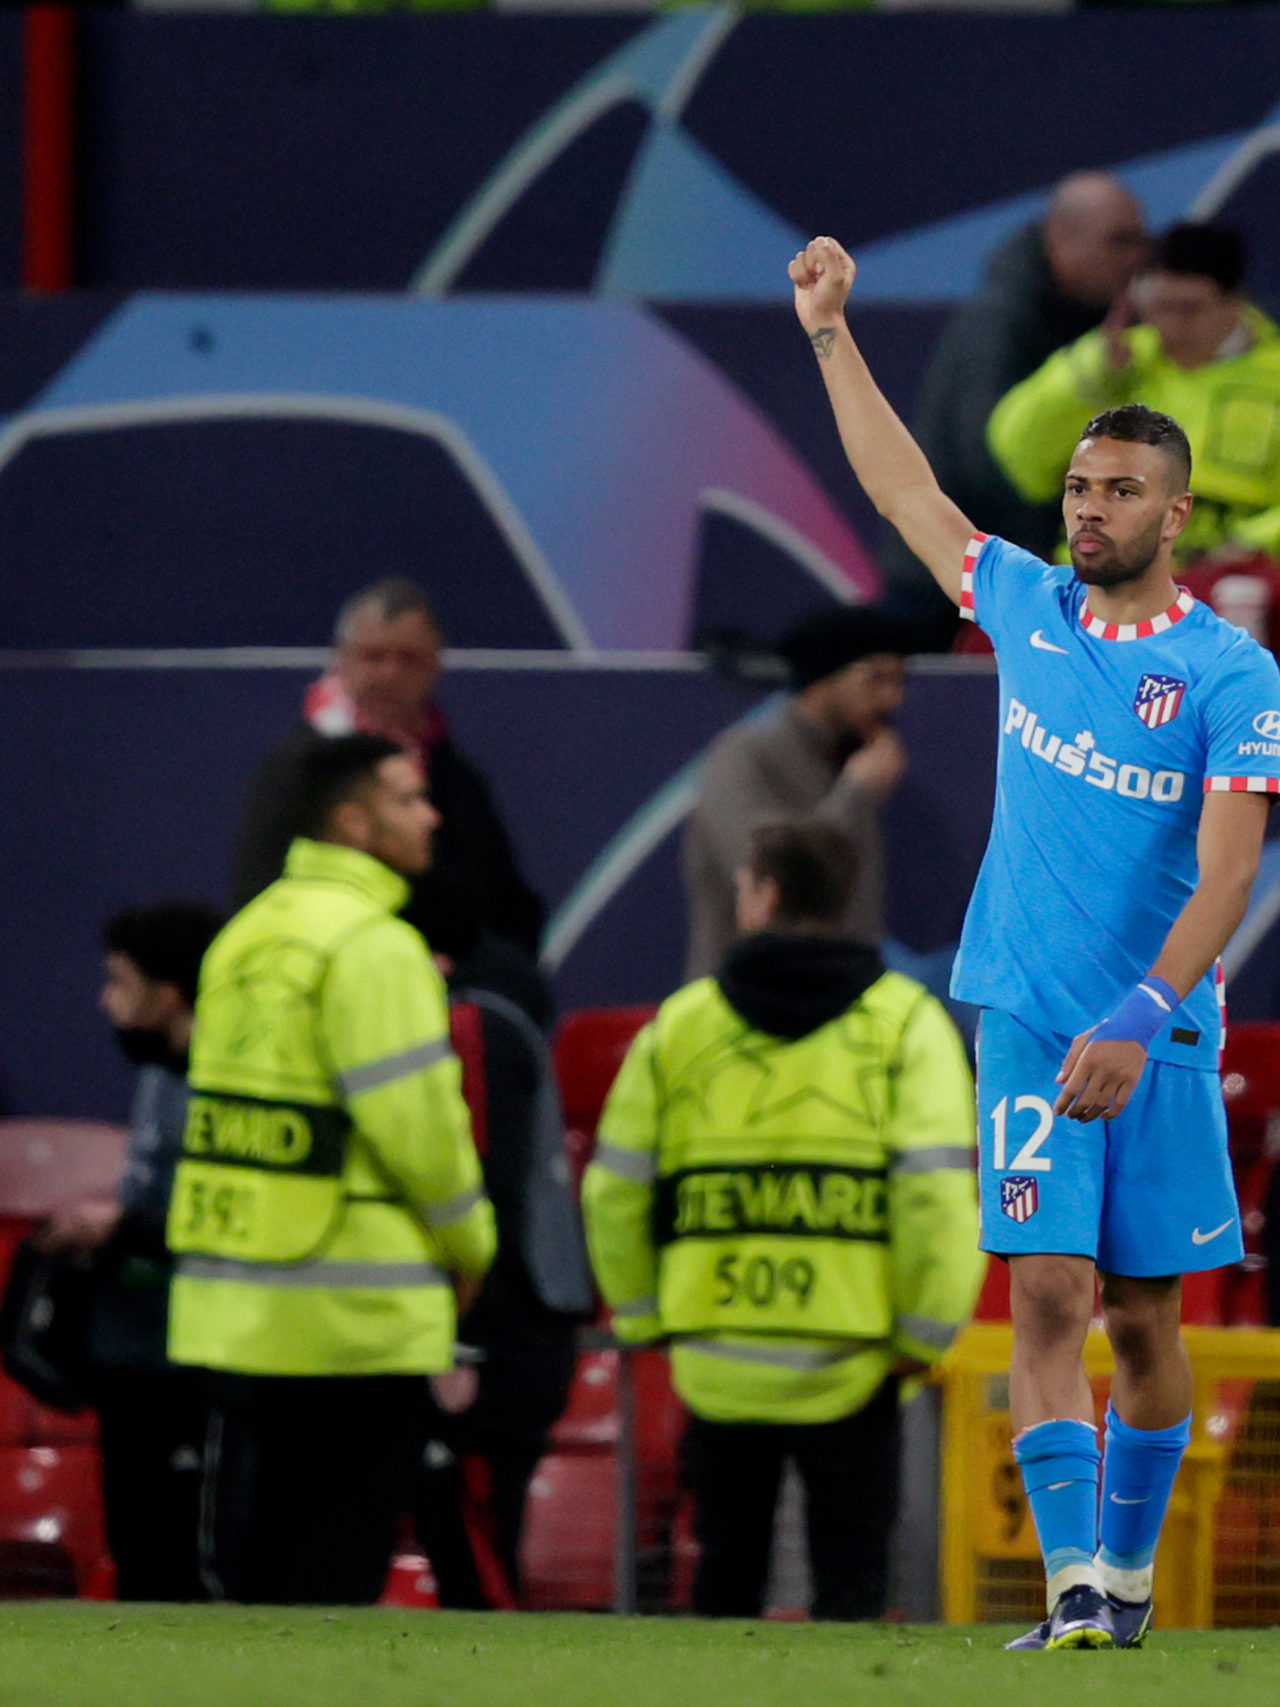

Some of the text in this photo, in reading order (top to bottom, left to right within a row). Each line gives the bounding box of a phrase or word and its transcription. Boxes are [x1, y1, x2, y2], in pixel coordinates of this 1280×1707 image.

[1004, 697, 1185, 802] Plus500
[990, 1094, 1055, 1171] 12
[716, 1254, 816, 1309] 509
